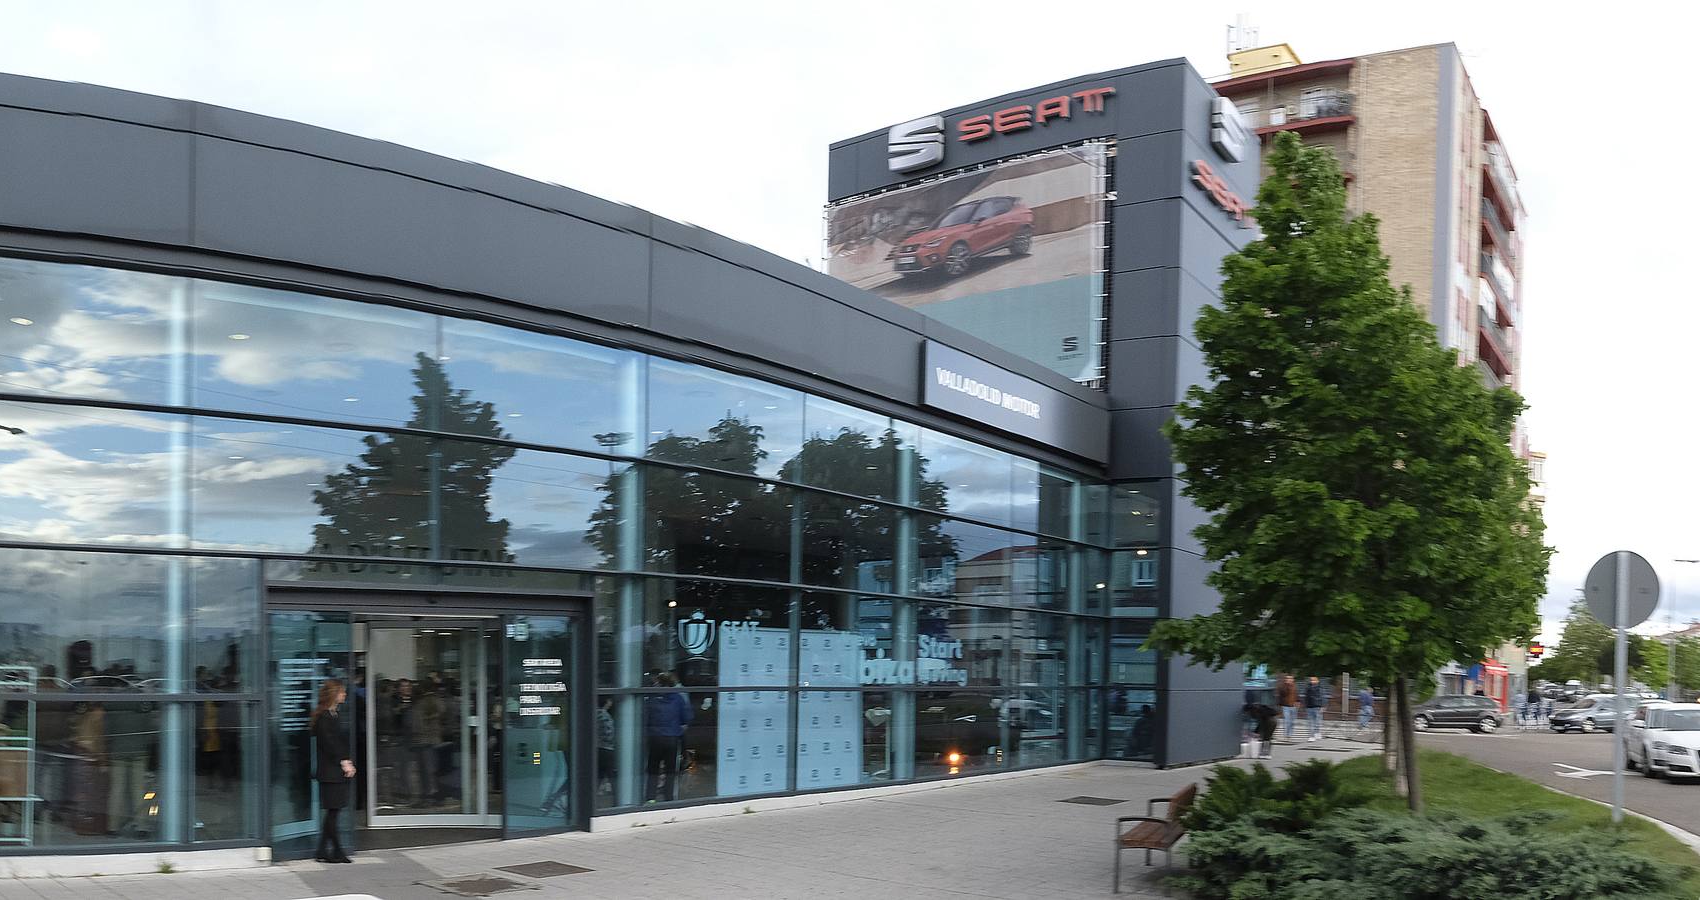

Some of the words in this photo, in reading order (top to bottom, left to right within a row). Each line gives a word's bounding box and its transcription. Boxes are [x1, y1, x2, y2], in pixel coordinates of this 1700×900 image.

[954, 86, 1117, 144] SEAT
[936, 367, 1002, 405] VALLADOLID
[1002, 392, 1041, 419] MOTOR
[918, 634, 963, 659] Start
